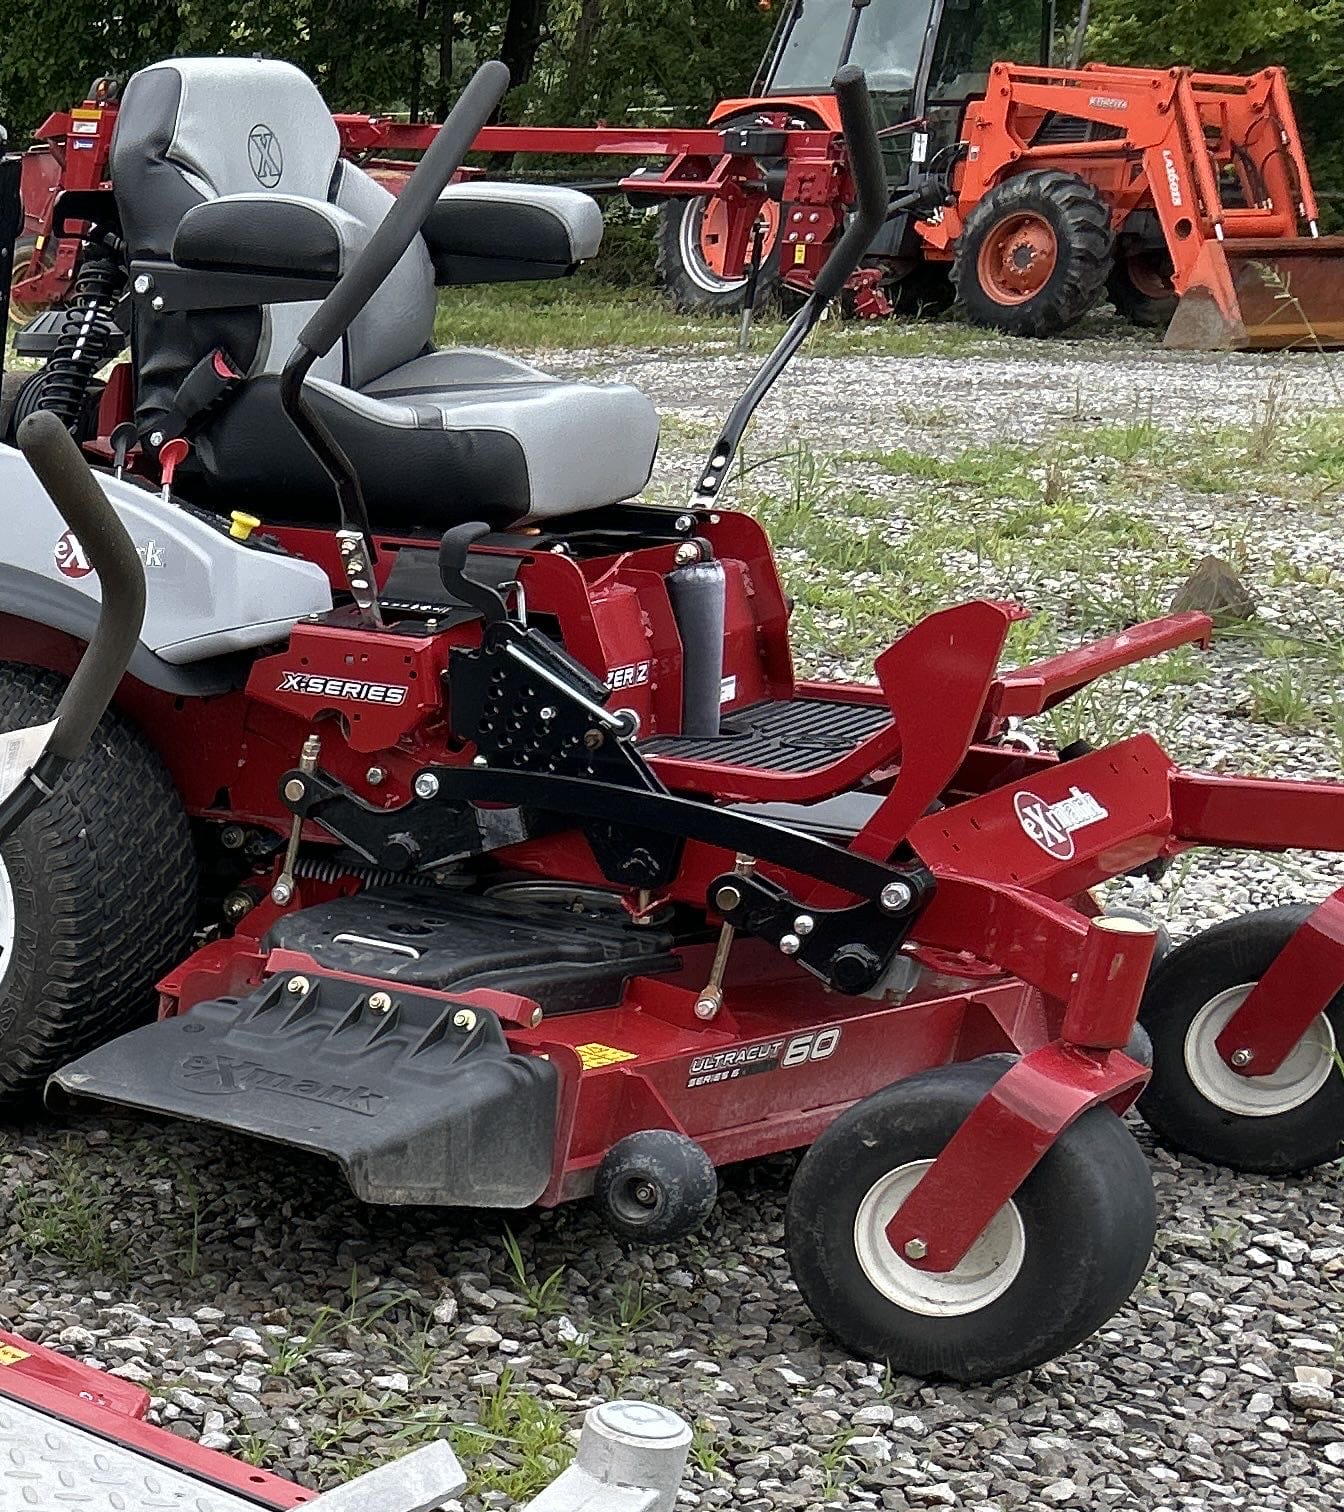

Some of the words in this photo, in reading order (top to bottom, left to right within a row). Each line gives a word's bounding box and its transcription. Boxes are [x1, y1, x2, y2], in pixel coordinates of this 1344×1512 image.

[54, 532, 166, 569] eXrk
[691, 1040, 785, 1073] ULTRACUT
[783, 1028, 840, 1067] 60
[687, 1069, 730, 1088] SERIES
